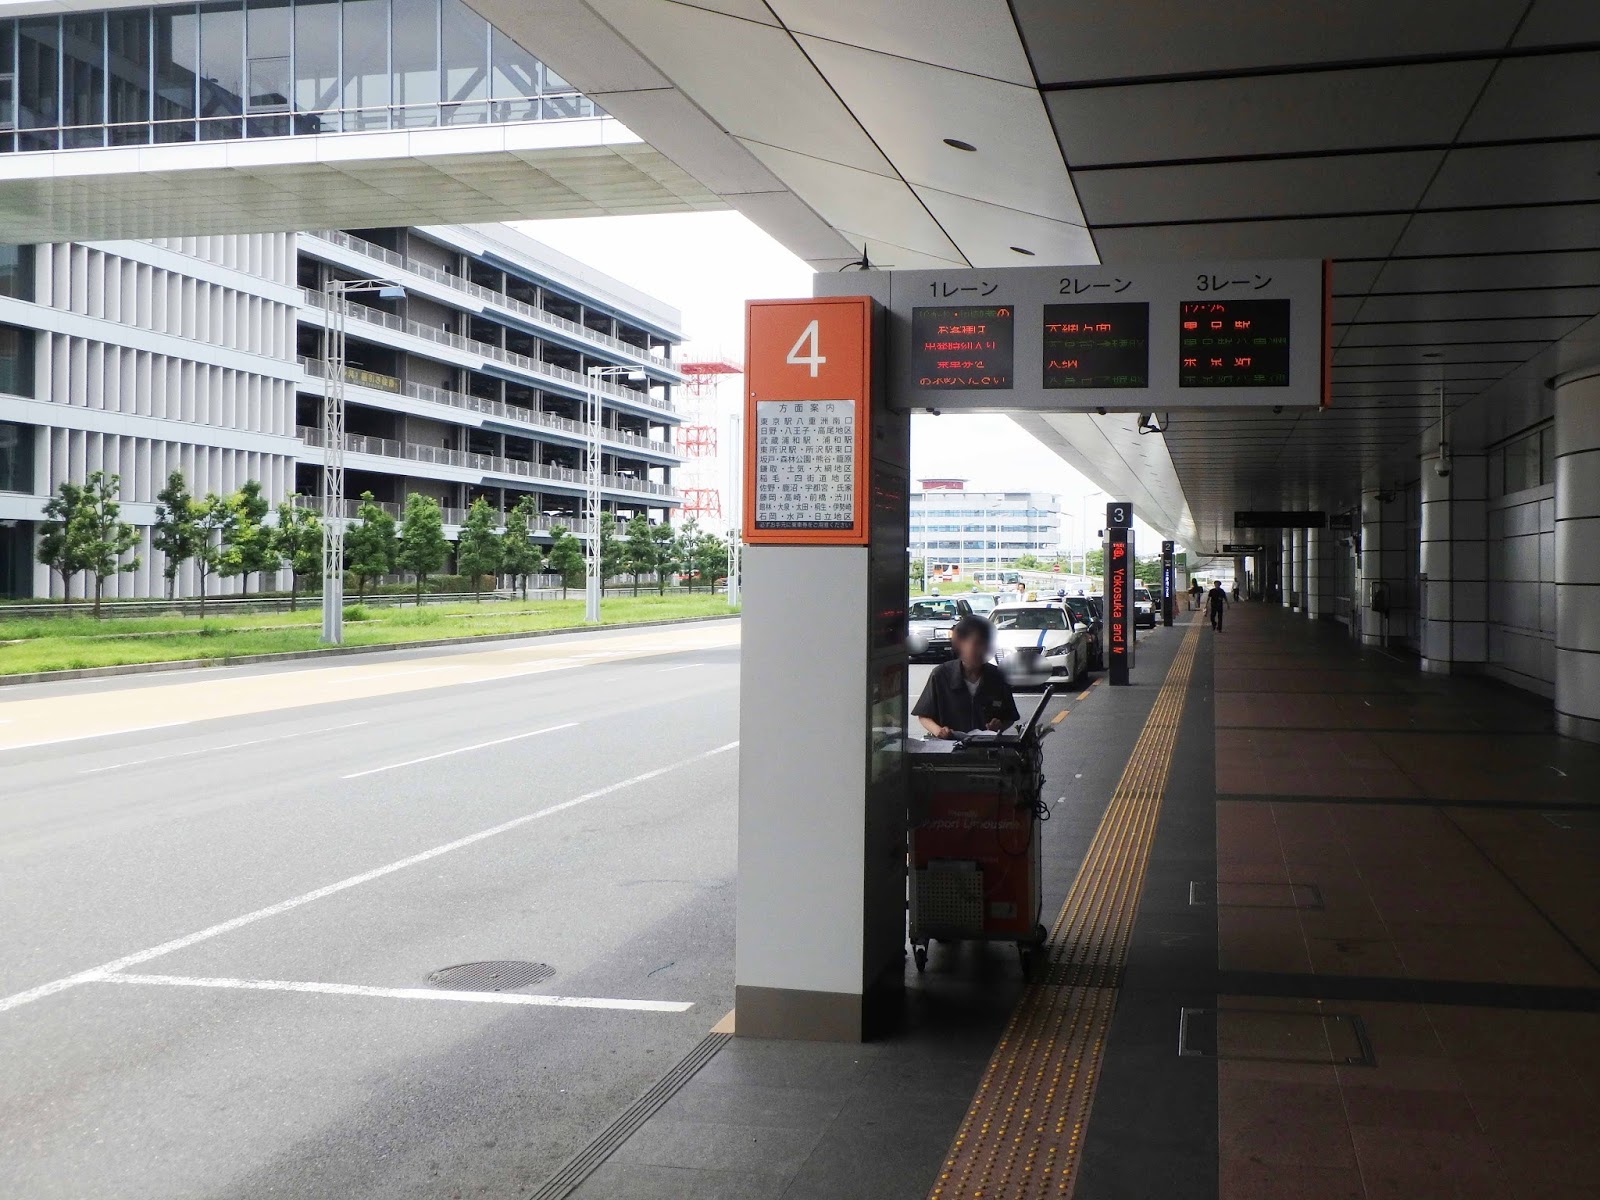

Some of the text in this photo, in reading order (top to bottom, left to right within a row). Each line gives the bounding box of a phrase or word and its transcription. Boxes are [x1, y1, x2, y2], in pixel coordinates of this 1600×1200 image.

[1059, 278, 1132, 294] 2レーン
[1197, 274, 1272, 291] 3レーン
[930, 281, 998, 297] 1レーン
[786, 319, 827, 378] 4
[779, 403, 835, 413] 方面案内
[760, 416, 853, 426] 東京駅八重洲南口
[760, 426, 852, 435] 日野・八王子・高尾地区
[760, 435, 853, 445] 武蔵浦和駅・浦和駅
[760, 445, 853, 454] 東所沢駅・所沢駅東口
[759, 474, 852, 483] 稲毛・四街道地区
[758, 512, 852, 521] 石岡・水戸・日立地区
[1113, 508, 1125, 523] 3
[1165, 543, 1171, 551] 2
[1113, 568, 1125, 618] Yokosuka
[1113, 623, 1125, 643] and
